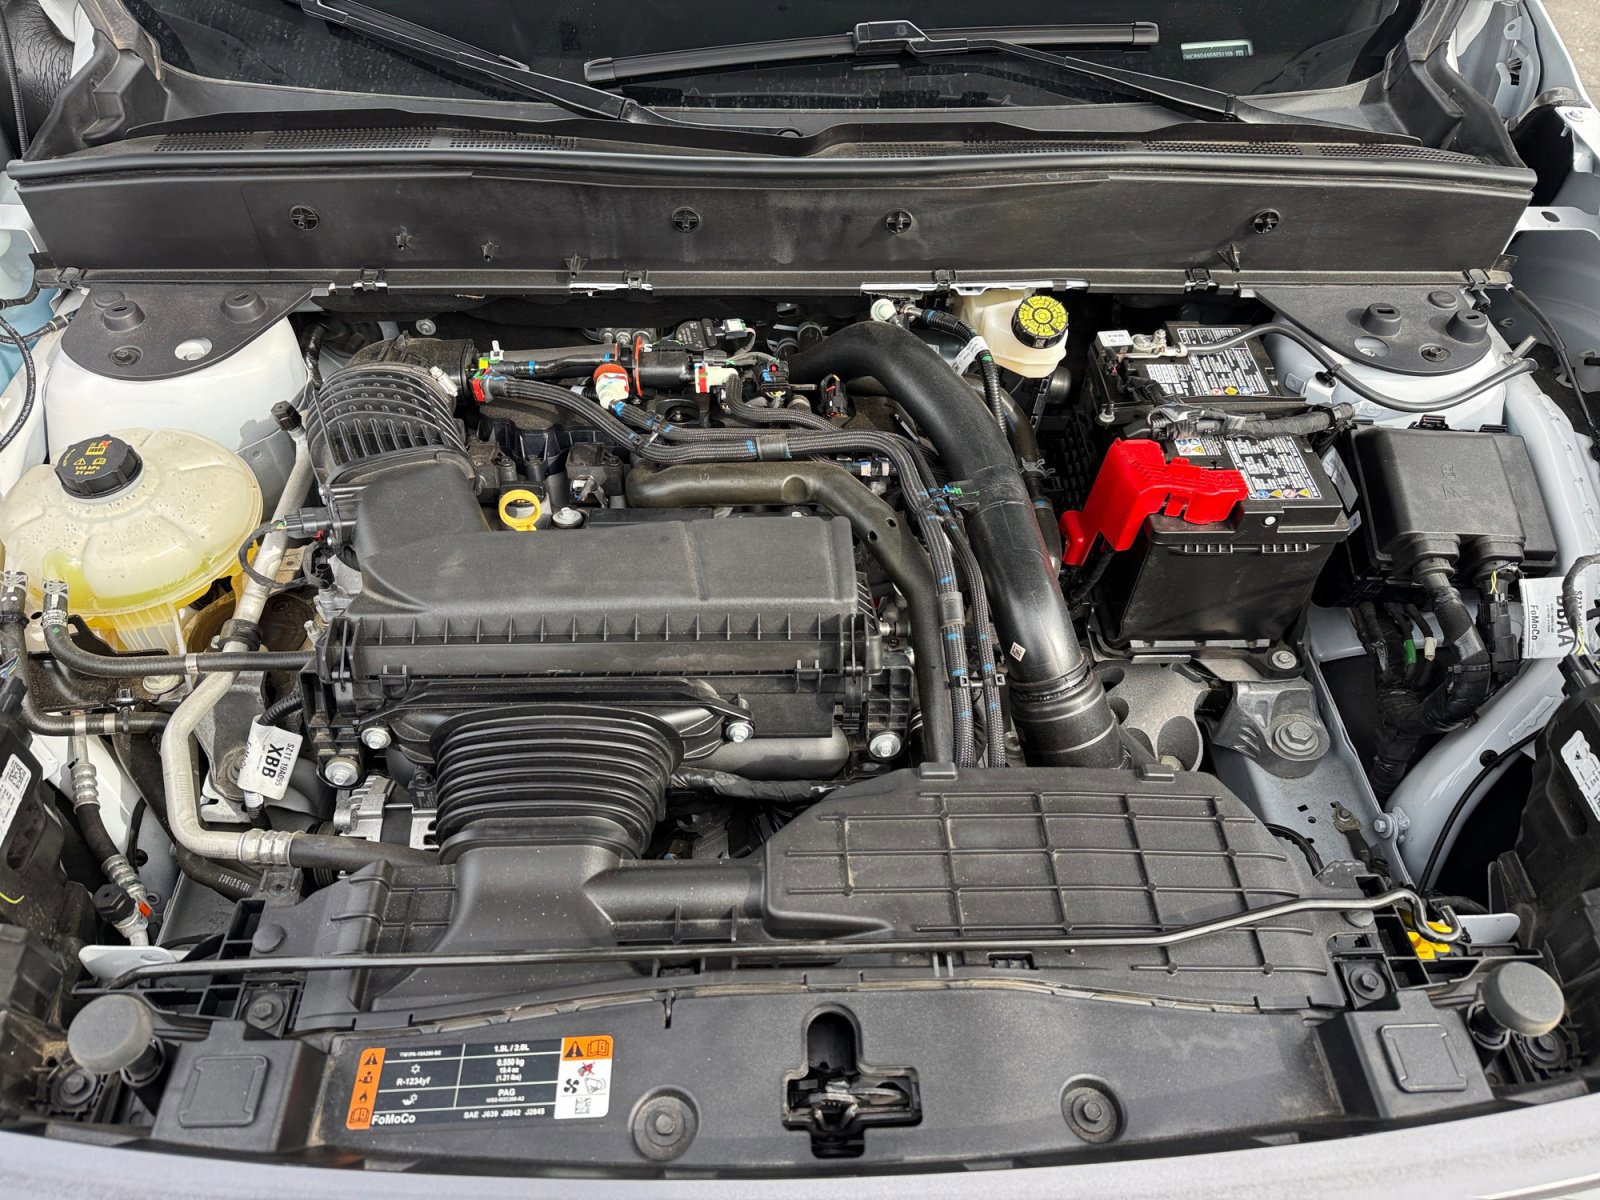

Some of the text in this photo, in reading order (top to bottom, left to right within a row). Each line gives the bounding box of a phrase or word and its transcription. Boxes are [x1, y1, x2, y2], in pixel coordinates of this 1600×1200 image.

[1531, 604, 1540, 641] FoMoCo
[284, 743, 295, 761] SZ1T
[262, 744, 284, 778] XBB
[514, 1043, 530, 1052] 2.0L
[515, 1057, 525, 1068] kg
[396, 1076, 431, 1087] R-1234yf
[498, 1088, 516, 1097] PAG
[371, 1114, 416, 1125] FoMoCo
[463, 1111, 479, 1119] SAE
[481, 1110, 499, 1118] J639
